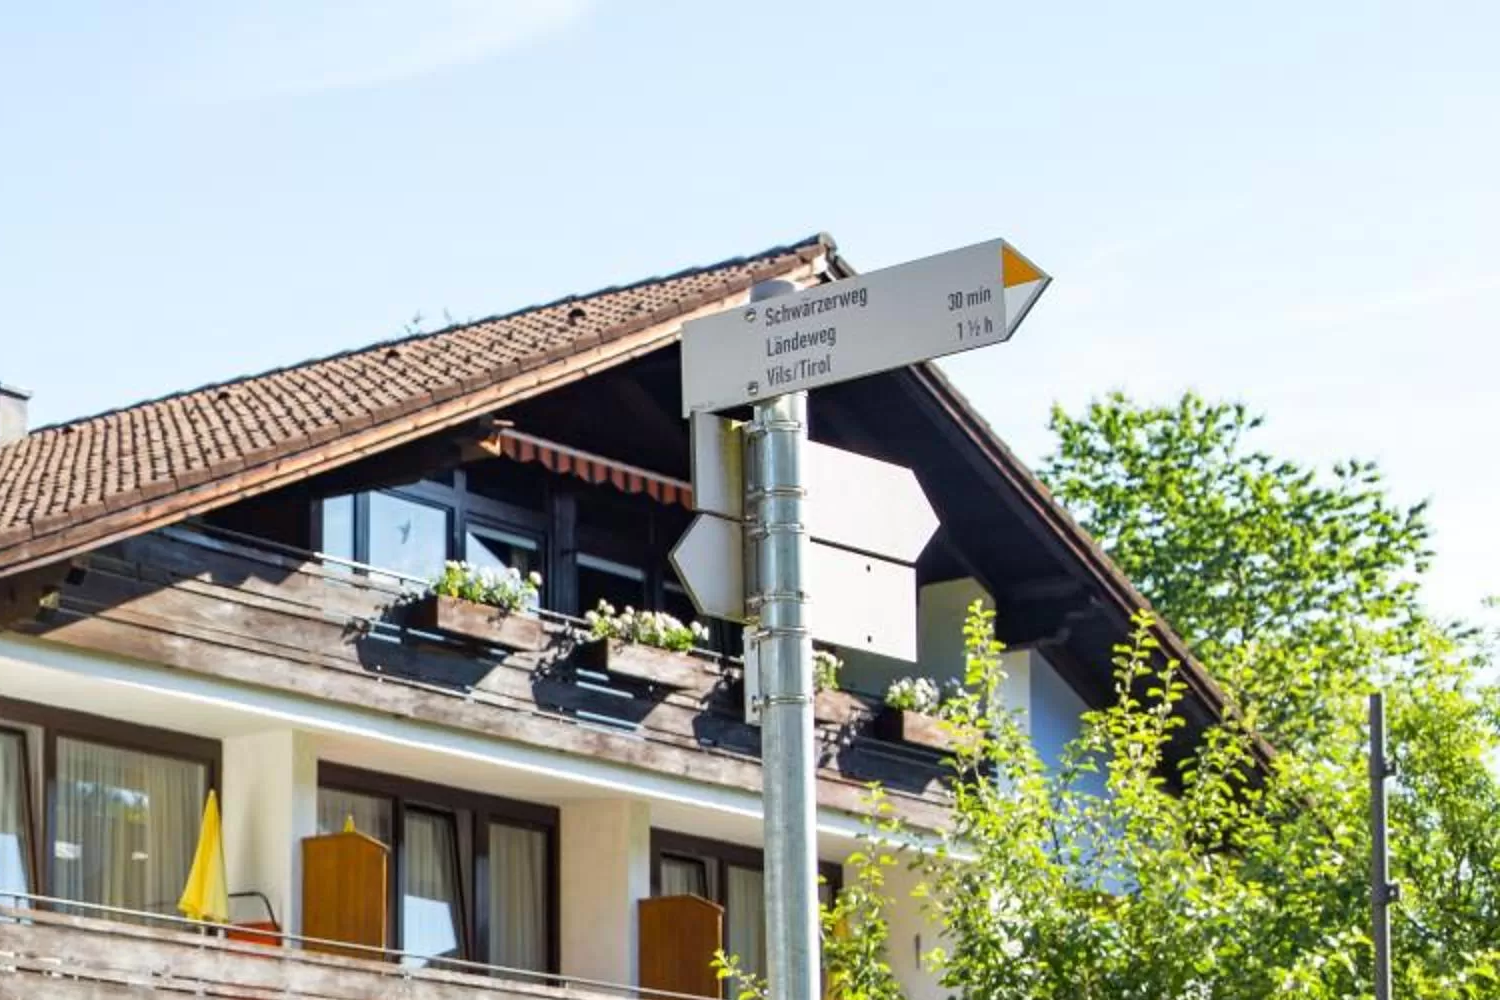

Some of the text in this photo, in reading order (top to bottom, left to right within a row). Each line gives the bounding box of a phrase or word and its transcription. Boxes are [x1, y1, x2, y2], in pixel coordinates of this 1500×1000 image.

[764, 285, 869, 327] Schwärzerweg
[947, 285, 992, 312] 30 min
[983, 315, 994, 334] h
[766, 325, 837, 358] Ländeweg
[766, 354, 832, 388] Vils/Tirol
